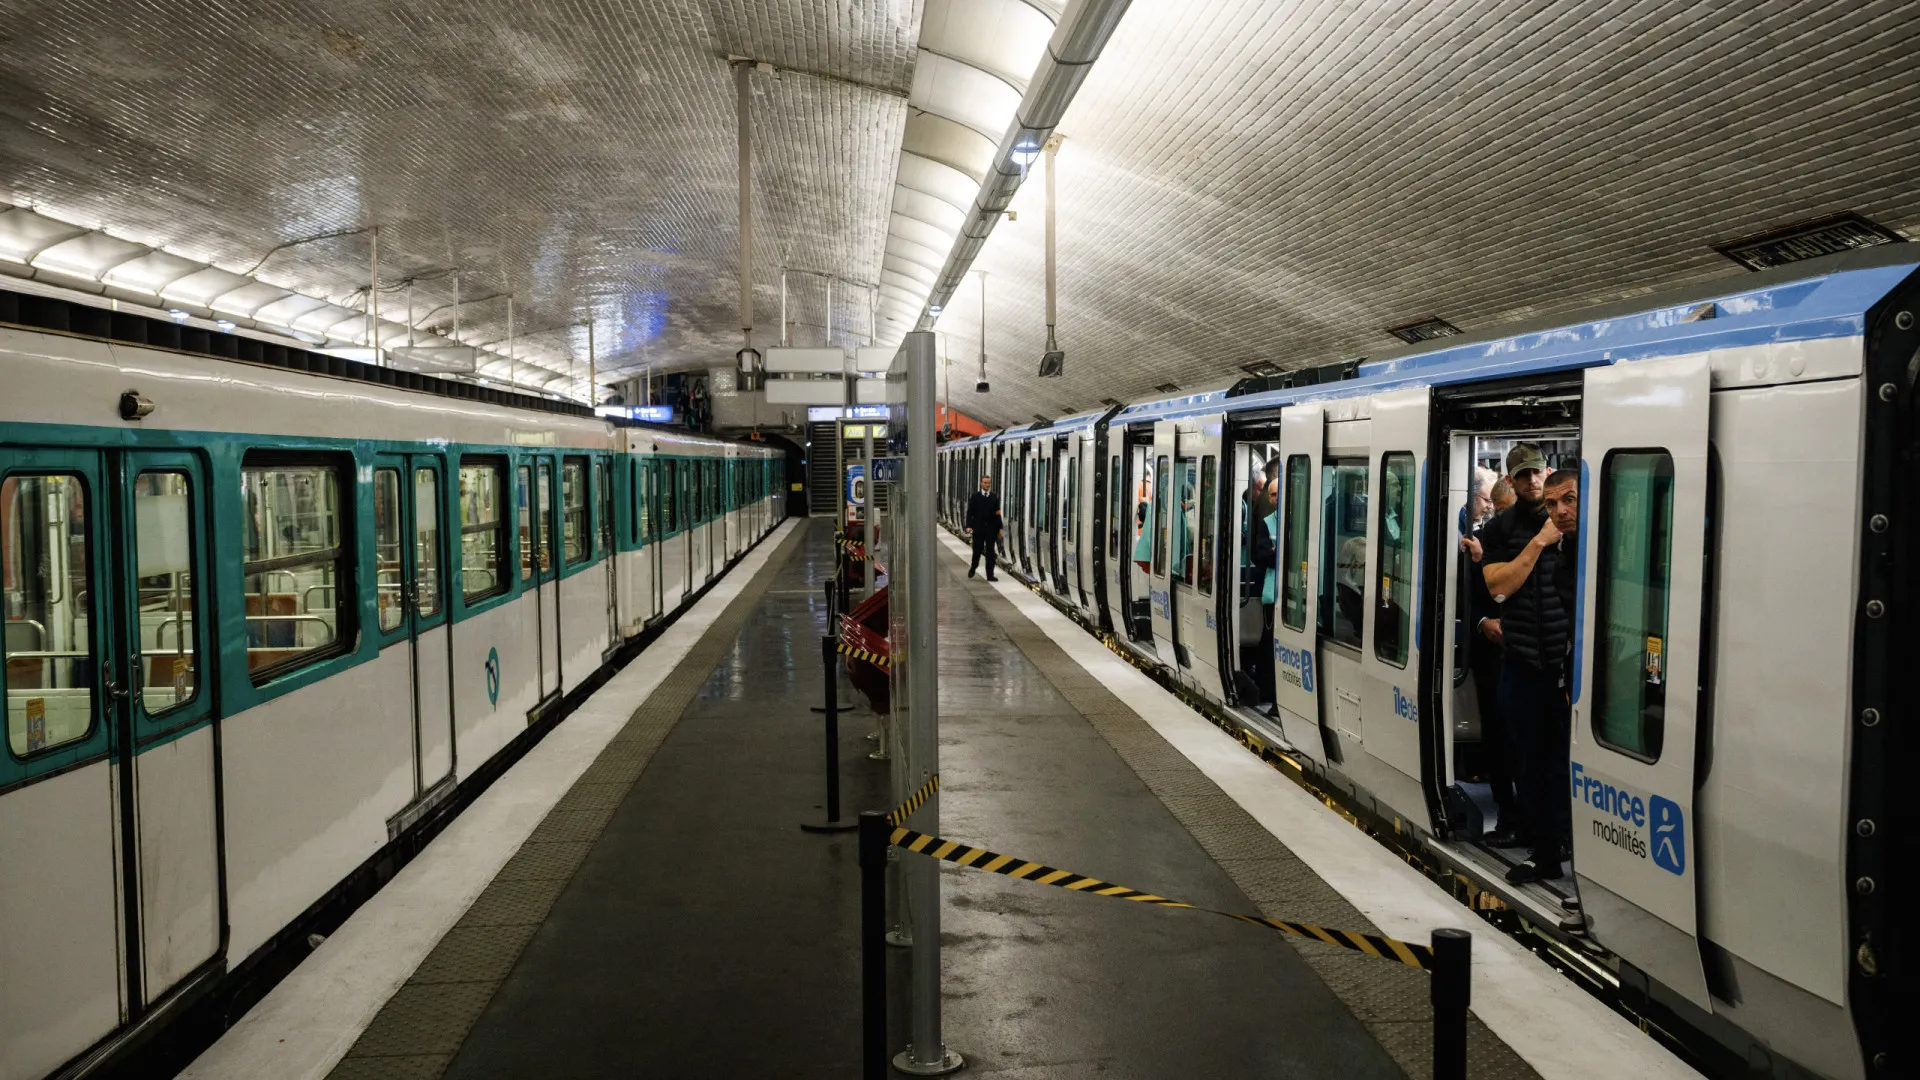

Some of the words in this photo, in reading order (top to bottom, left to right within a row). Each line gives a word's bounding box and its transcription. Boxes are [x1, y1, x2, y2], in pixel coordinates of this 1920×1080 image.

[1274, 638, 1301, 670] France
[1571, 761, 1646, 828] France
[1593, 820, 1647, 859] mobilités
